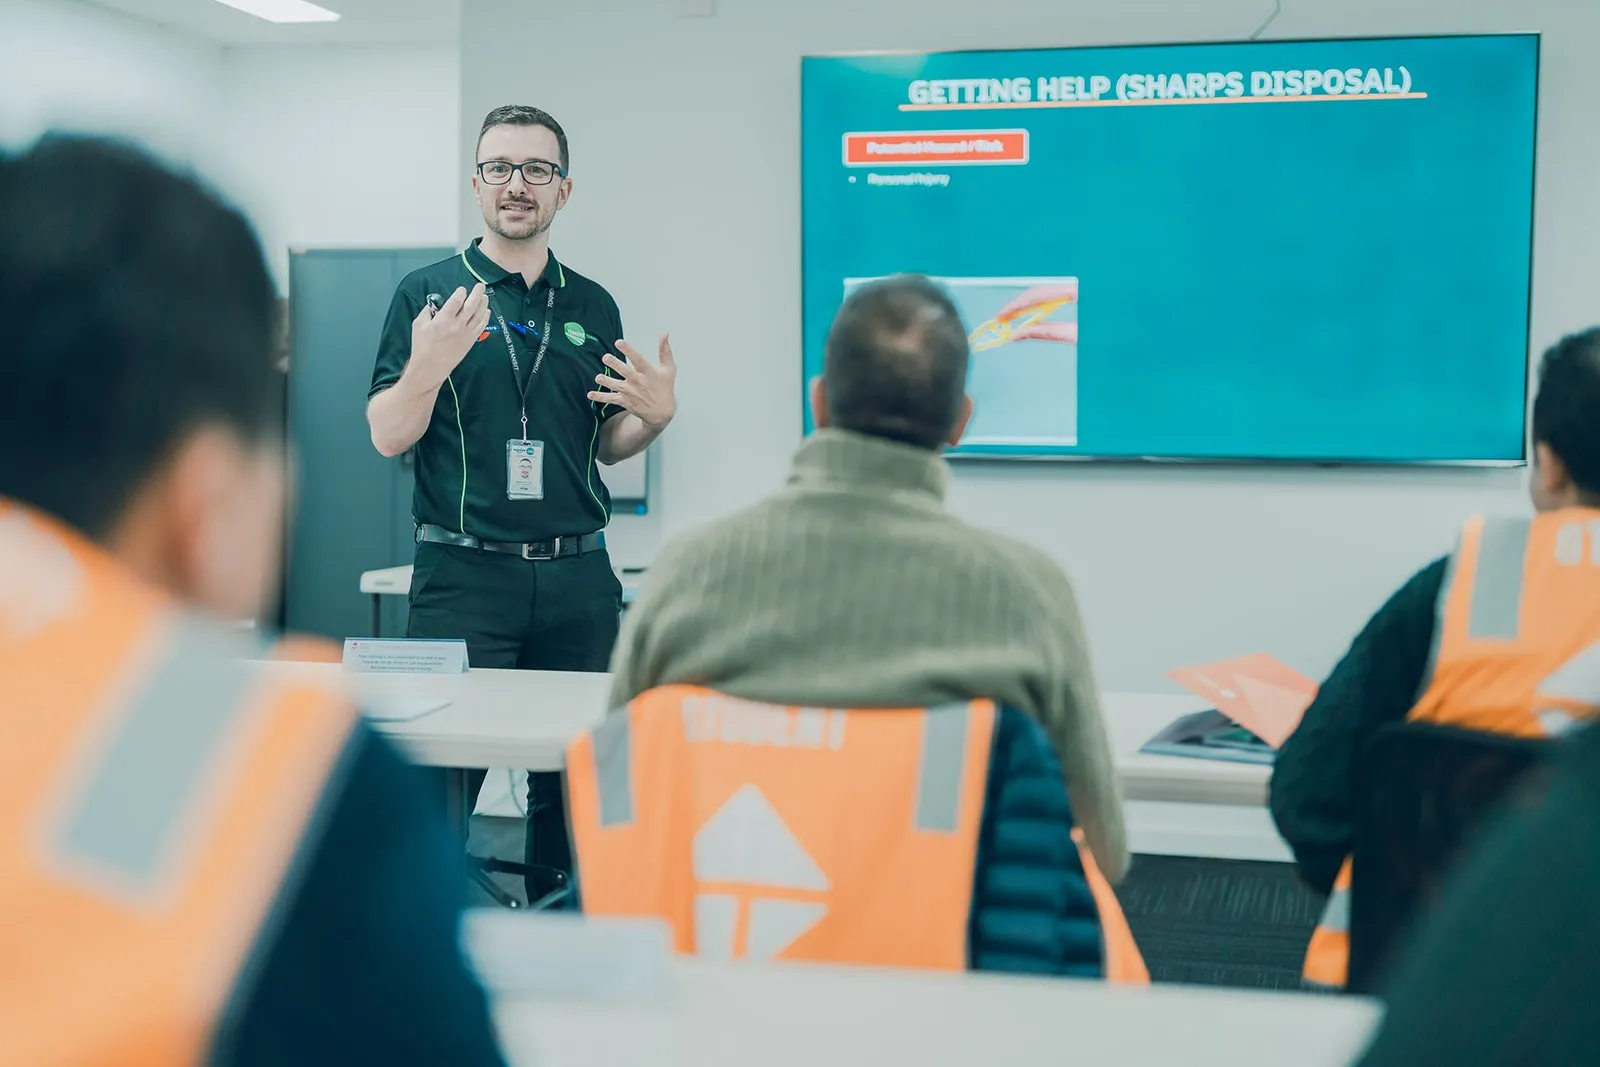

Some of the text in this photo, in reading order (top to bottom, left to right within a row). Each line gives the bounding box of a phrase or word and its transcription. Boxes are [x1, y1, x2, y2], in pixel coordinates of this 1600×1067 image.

[908, 66, 1412, 104] GETTING HELP (SHARPS DISPOSAL)
[497, 315, 519, 371] TORRENS TRANSIT
[532, 321, 551, 374] TORRENS TRANSIT
